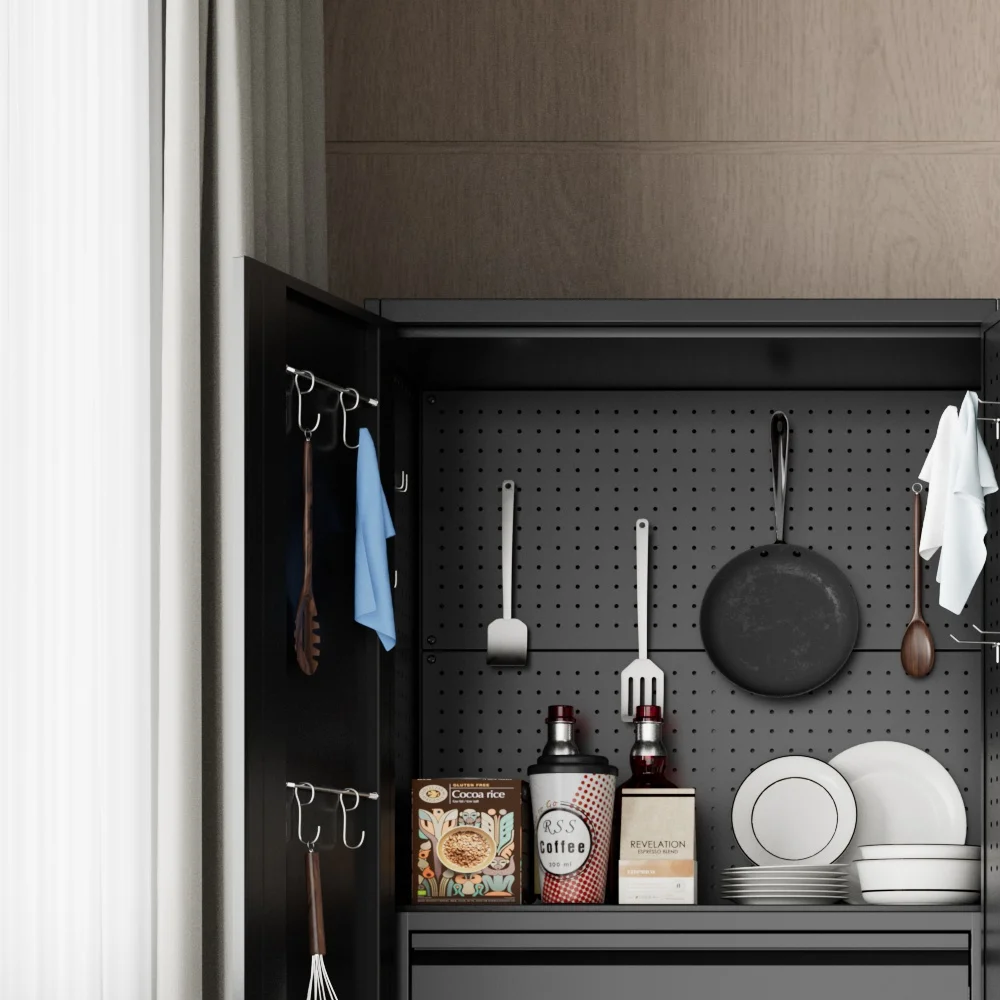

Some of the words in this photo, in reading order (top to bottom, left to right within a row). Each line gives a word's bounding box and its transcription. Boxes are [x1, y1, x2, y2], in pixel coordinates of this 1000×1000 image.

[452, 790, 484, 798] Cocoa
[486, 790, 506, 798] rice
[540, 840, 585, 854] Coffee
[630, 840, 686, 848] REVELATION
